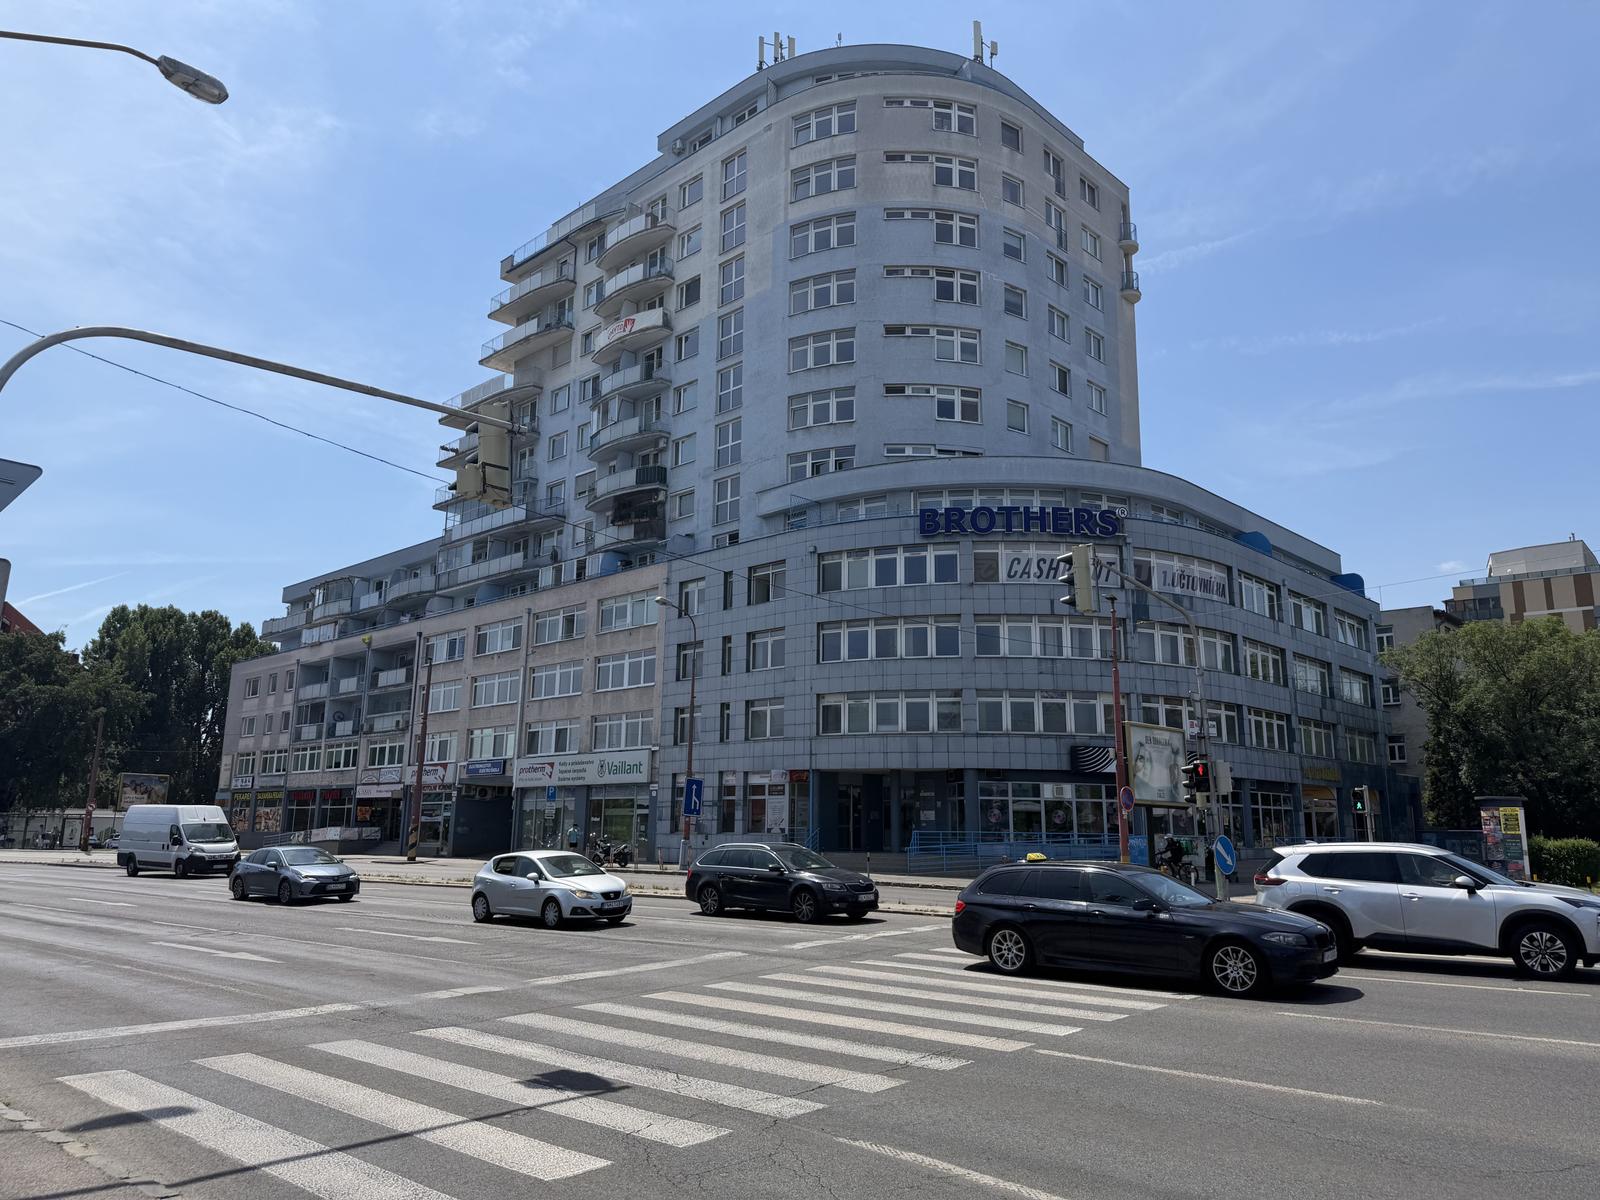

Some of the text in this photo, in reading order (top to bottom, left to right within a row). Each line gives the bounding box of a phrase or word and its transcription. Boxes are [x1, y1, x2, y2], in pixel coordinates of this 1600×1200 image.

[519, 765, 546, 776] protherm
[607, 761, 643, 776] Vaillant
[549, 787, 554, 796] P
